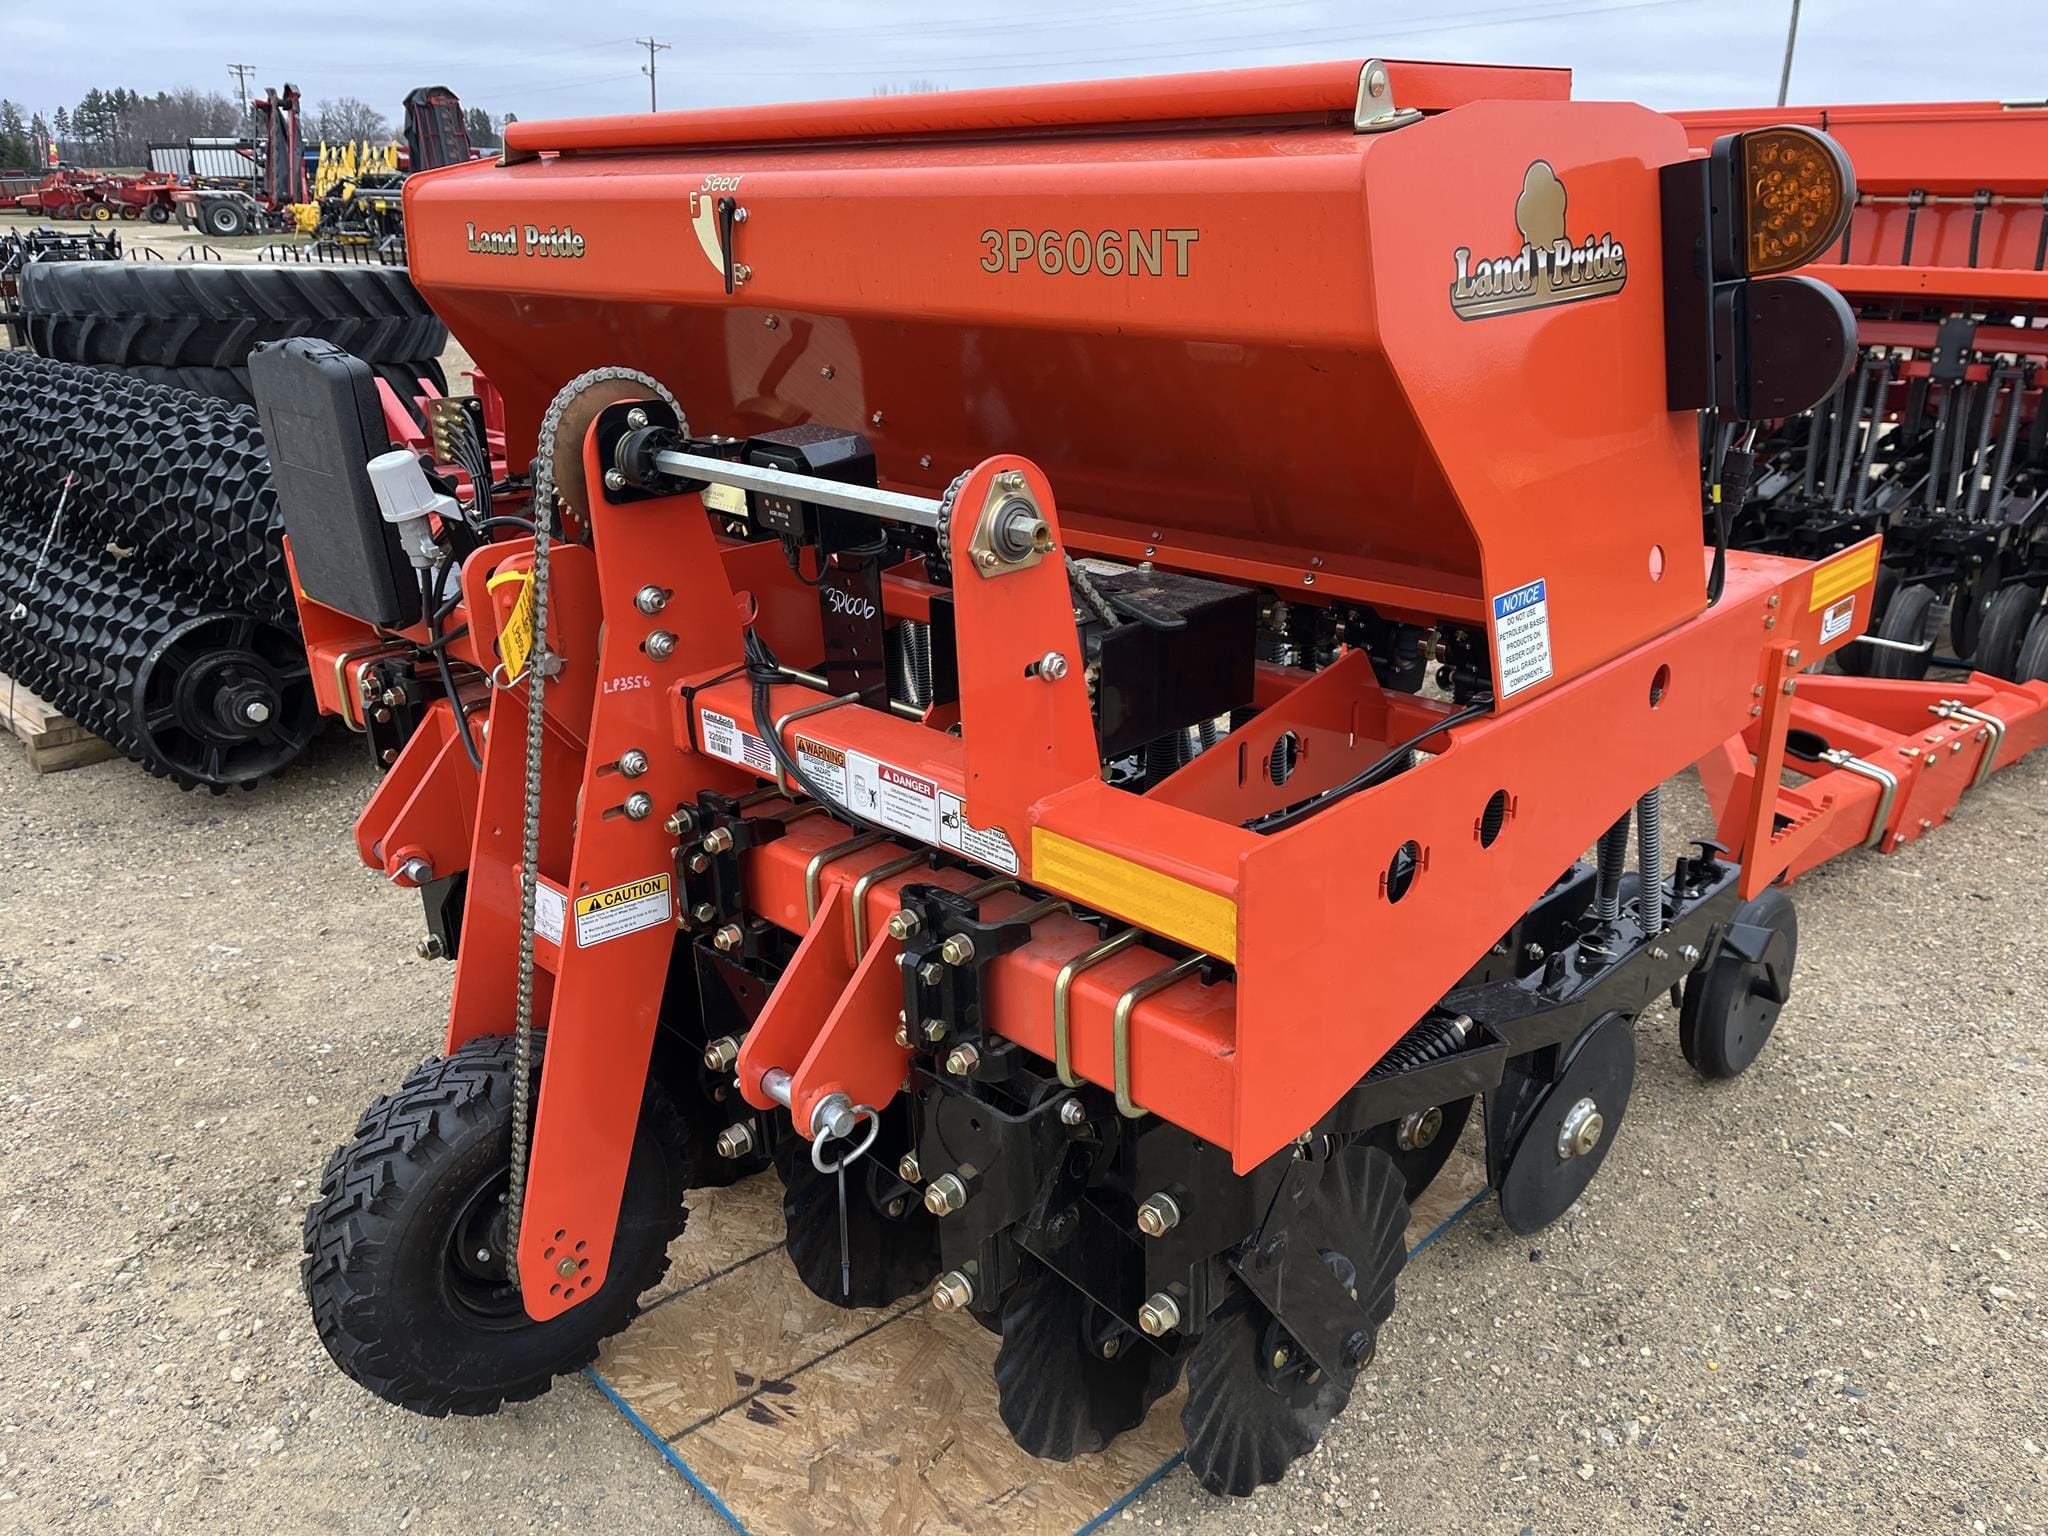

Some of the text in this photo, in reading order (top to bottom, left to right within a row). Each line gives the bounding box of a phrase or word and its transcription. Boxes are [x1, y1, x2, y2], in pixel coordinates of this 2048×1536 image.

[701, 173, 744, 191] Seed
[690, 192, 697, 214] F
[466, 222, 585, 258] Land Pride
[980, 228, 1199, 277] 3P606NT
[1454, 232, 1624, 299] Land Pride
[1502, 585, 1540, 614] NOTICE
[1500, 616, 1546, 641] PETROLEUM BASED
[1507, 607, 1537, 626] DO NOT USE
[1506, 631, 1541, 651] PRODUCTS ON
[1506, 641, 1544, 664] FEEDER CUP OR
[1504, 651, 1547, 678] SMALL GRASS CUP
[603, 675, 651, 695] LP3556
[805, 741, 844, 765] WARNING
[893, 772, 931, 796] DANGER
[604, 879, 660, 906] CAUTION
